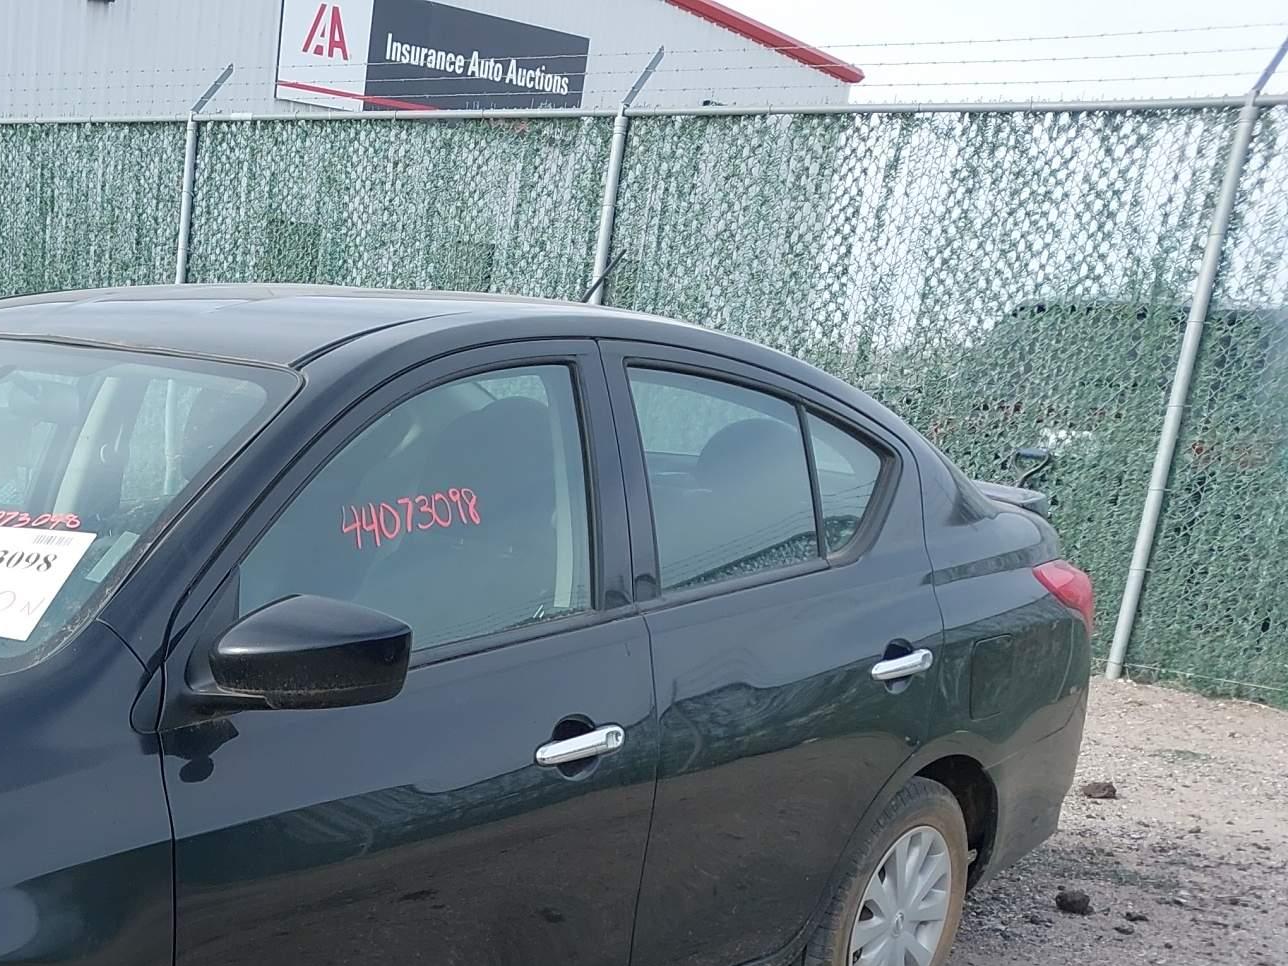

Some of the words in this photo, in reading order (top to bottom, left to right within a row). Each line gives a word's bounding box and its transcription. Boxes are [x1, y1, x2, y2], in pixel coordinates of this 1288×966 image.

[386, 33, 464, 74] Insurance
[468, 51, 502, 82] Auto
[506, 59, 569, 95] Auctions
[342, 488, 480, 549] 44073098
